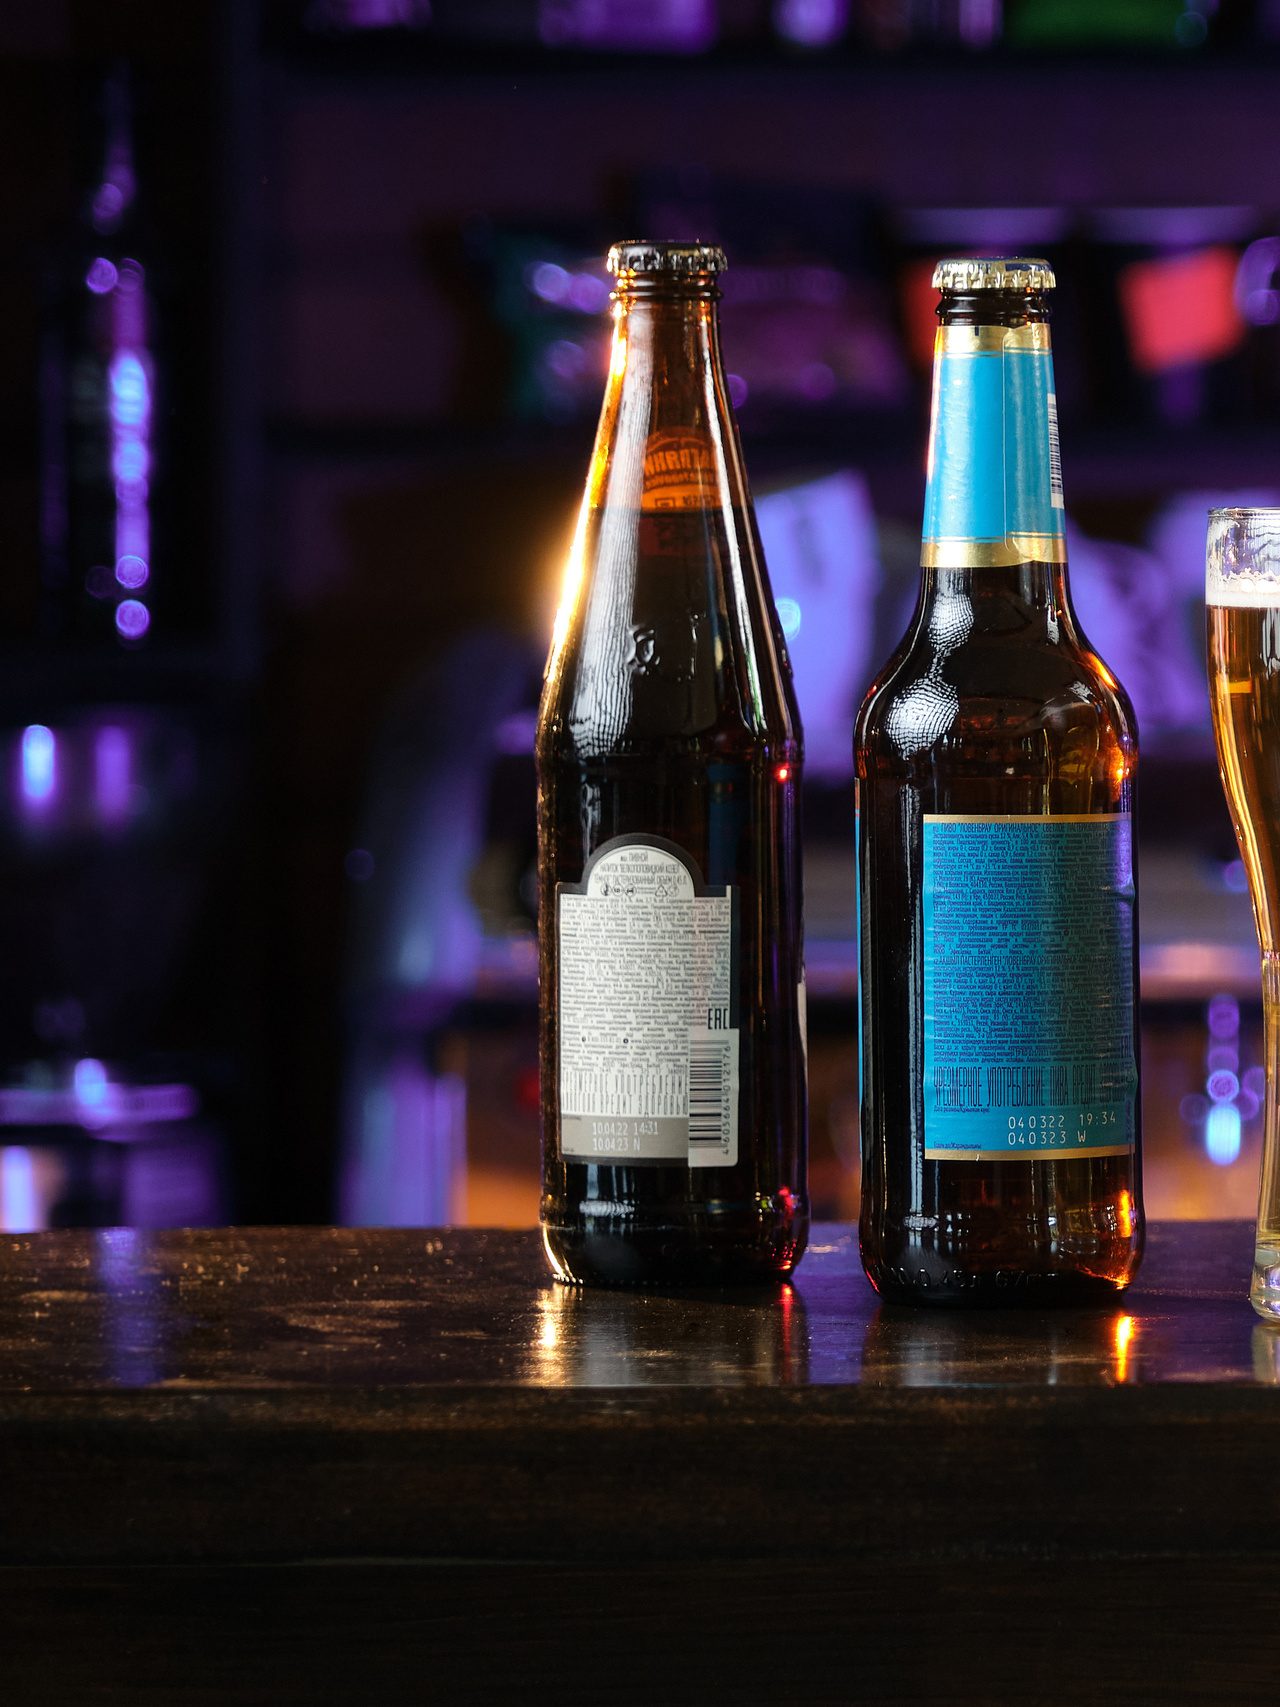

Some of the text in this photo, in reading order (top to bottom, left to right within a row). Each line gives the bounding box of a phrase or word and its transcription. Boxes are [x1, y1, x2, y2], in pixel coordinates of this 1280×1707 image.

[934, 1067, 982, 1106] ЧРЕЗМЕРНОЕ
[986, 1066, 1045, 1107] УПОТРЕБЛЕНИЕ
[1050, 1066, 1068, 1105] ПИВА
[1008, 1111, 1116, 1129] 040322 19:34
[634, 1138, 641, 1151] N
[1008, 1130, 1086, 1146] 040323 W
